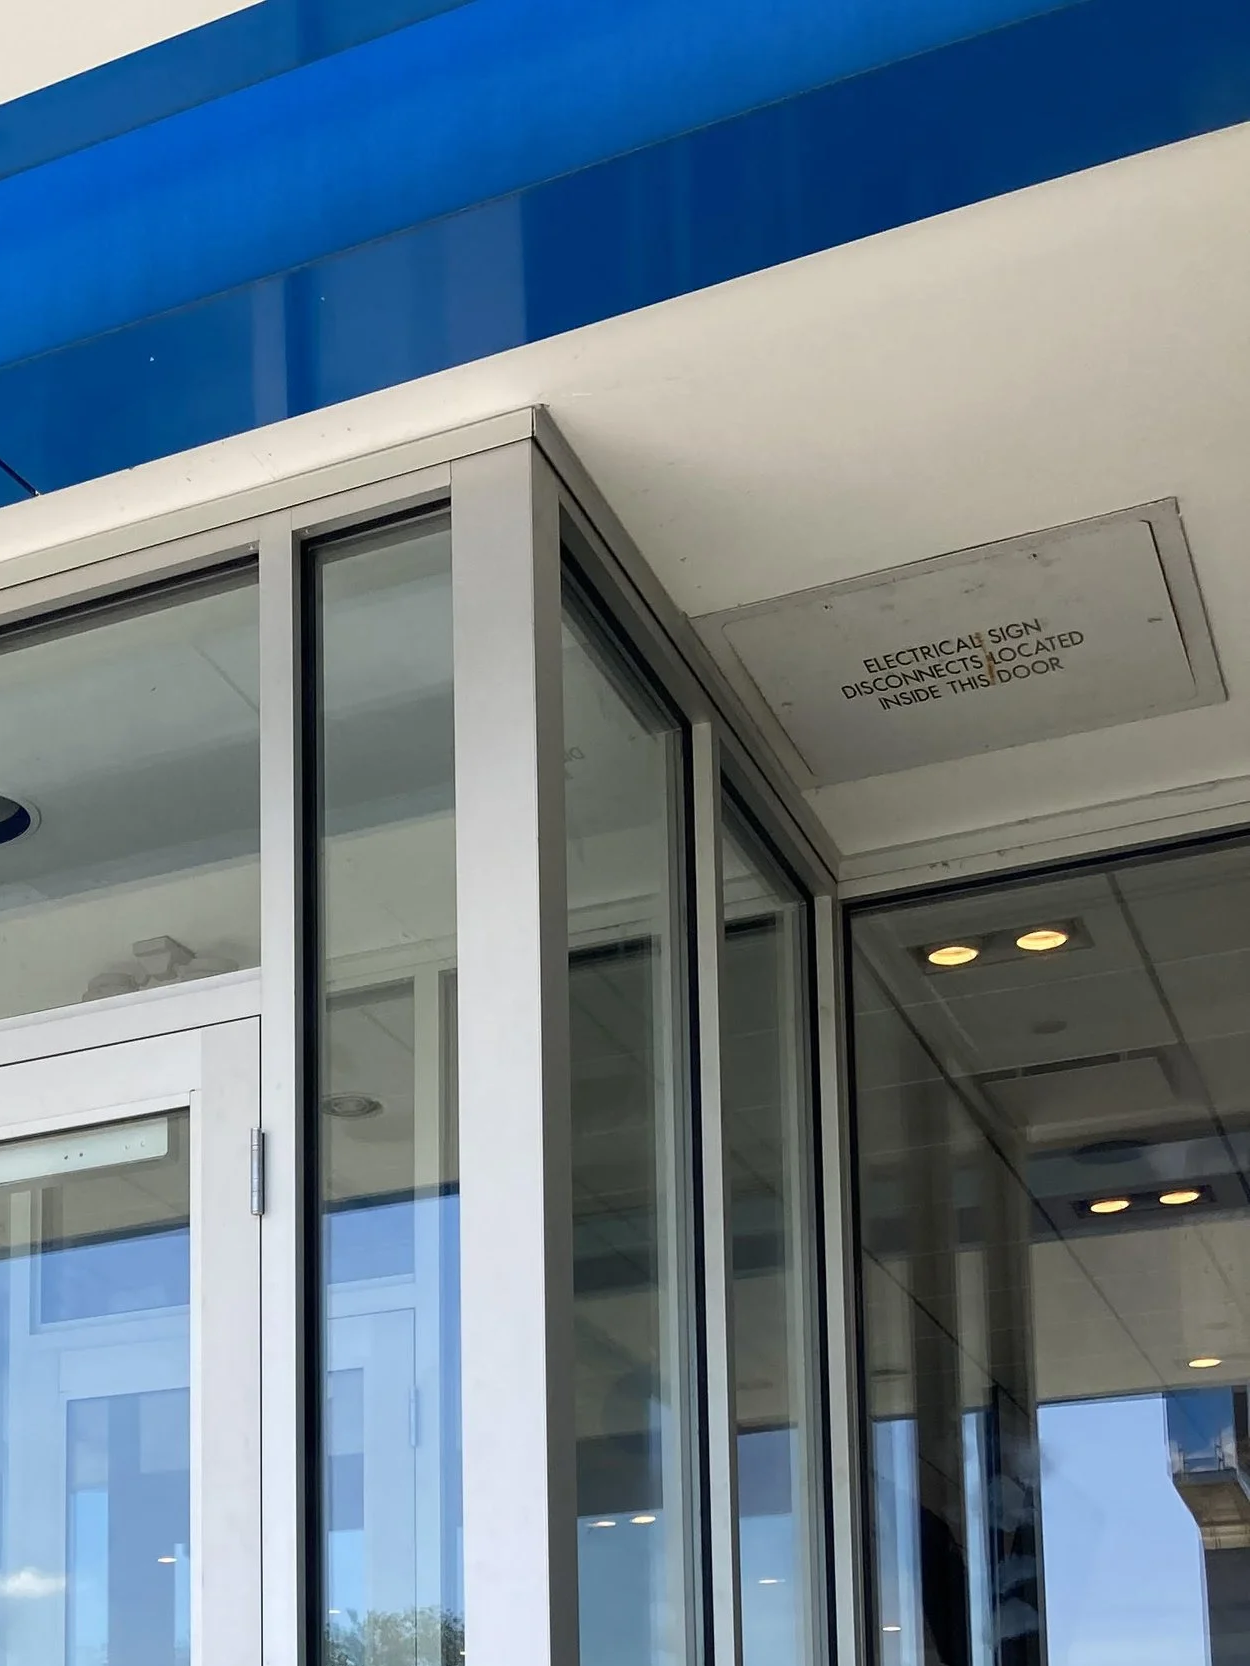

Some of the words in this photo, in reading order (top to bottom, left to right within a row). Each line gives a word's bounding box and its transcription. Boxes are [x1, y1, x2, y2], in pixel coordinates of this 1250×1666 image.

[841, 654, 984, 699] DISCONNECTS
[989, 630, 1084, 665] LOCATED
[863, 634, 983, 674] ELECTRICAL
[988, 618, 1042, 645] SIGN
[878, 684, 942, 710] INSIDE
[946, 673, 991, 695] THIS
[996, 656, 1064, 684] DOOR
